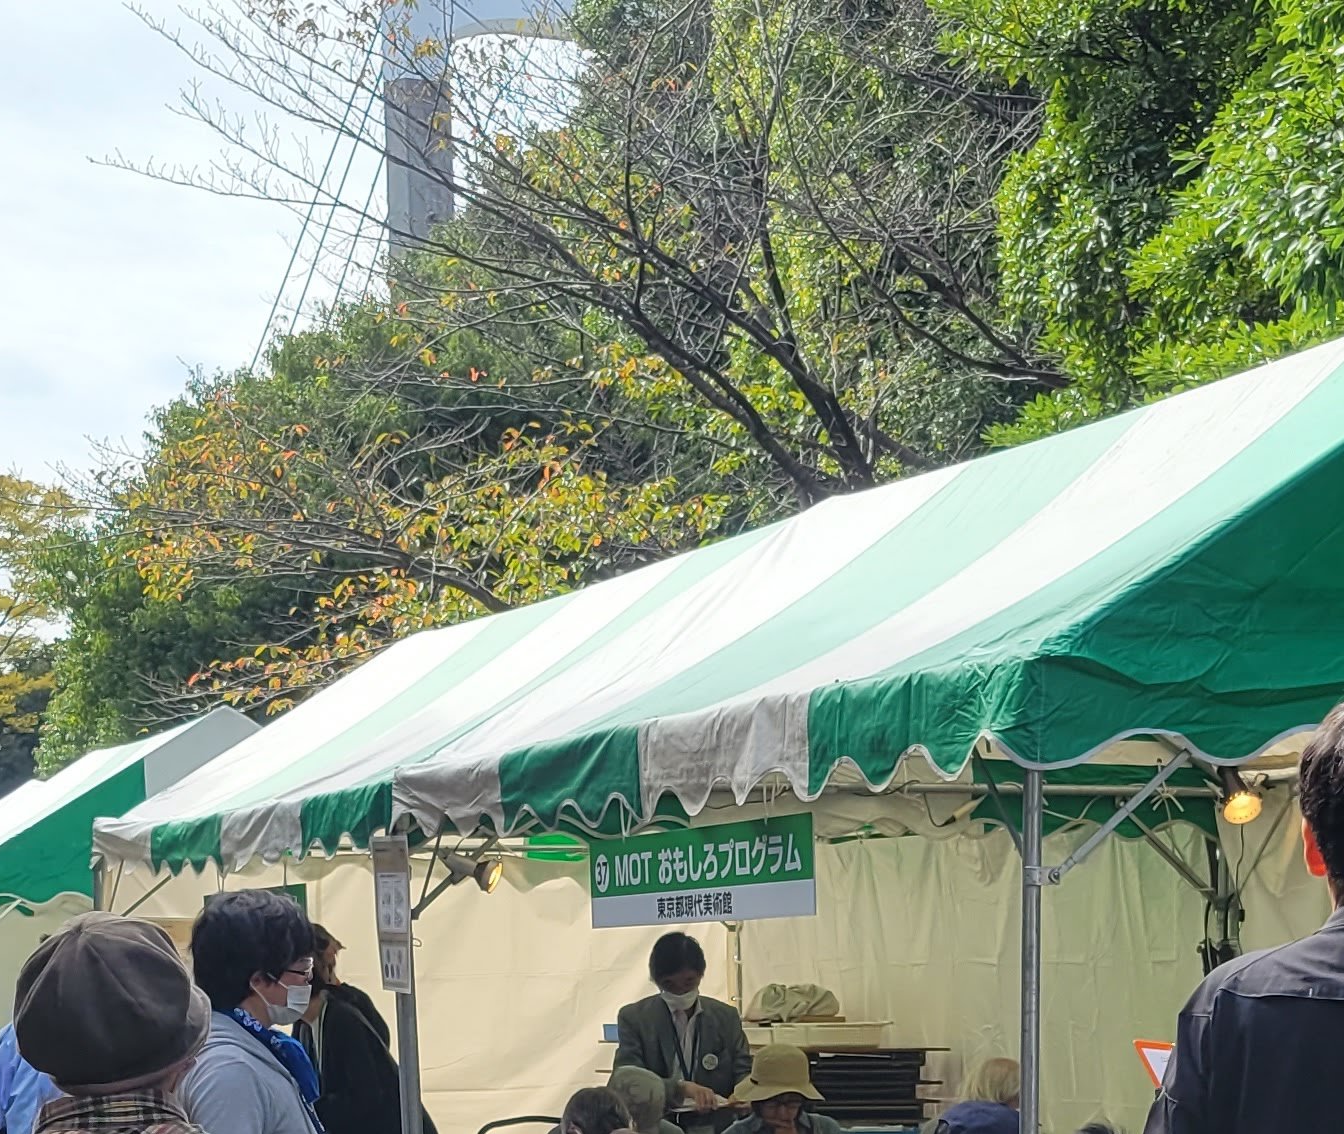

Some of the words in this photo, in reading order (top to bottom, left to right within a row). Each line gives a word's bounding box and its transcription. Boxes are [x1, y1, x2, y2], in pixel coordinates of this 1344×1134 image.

[596, 860, 608, 887] 37
[615, 851, 653, 887] MOT
[657, 833, 803, 885] おもしろプログラム
[656, 891, 733, 919] 東京都現代美術館
